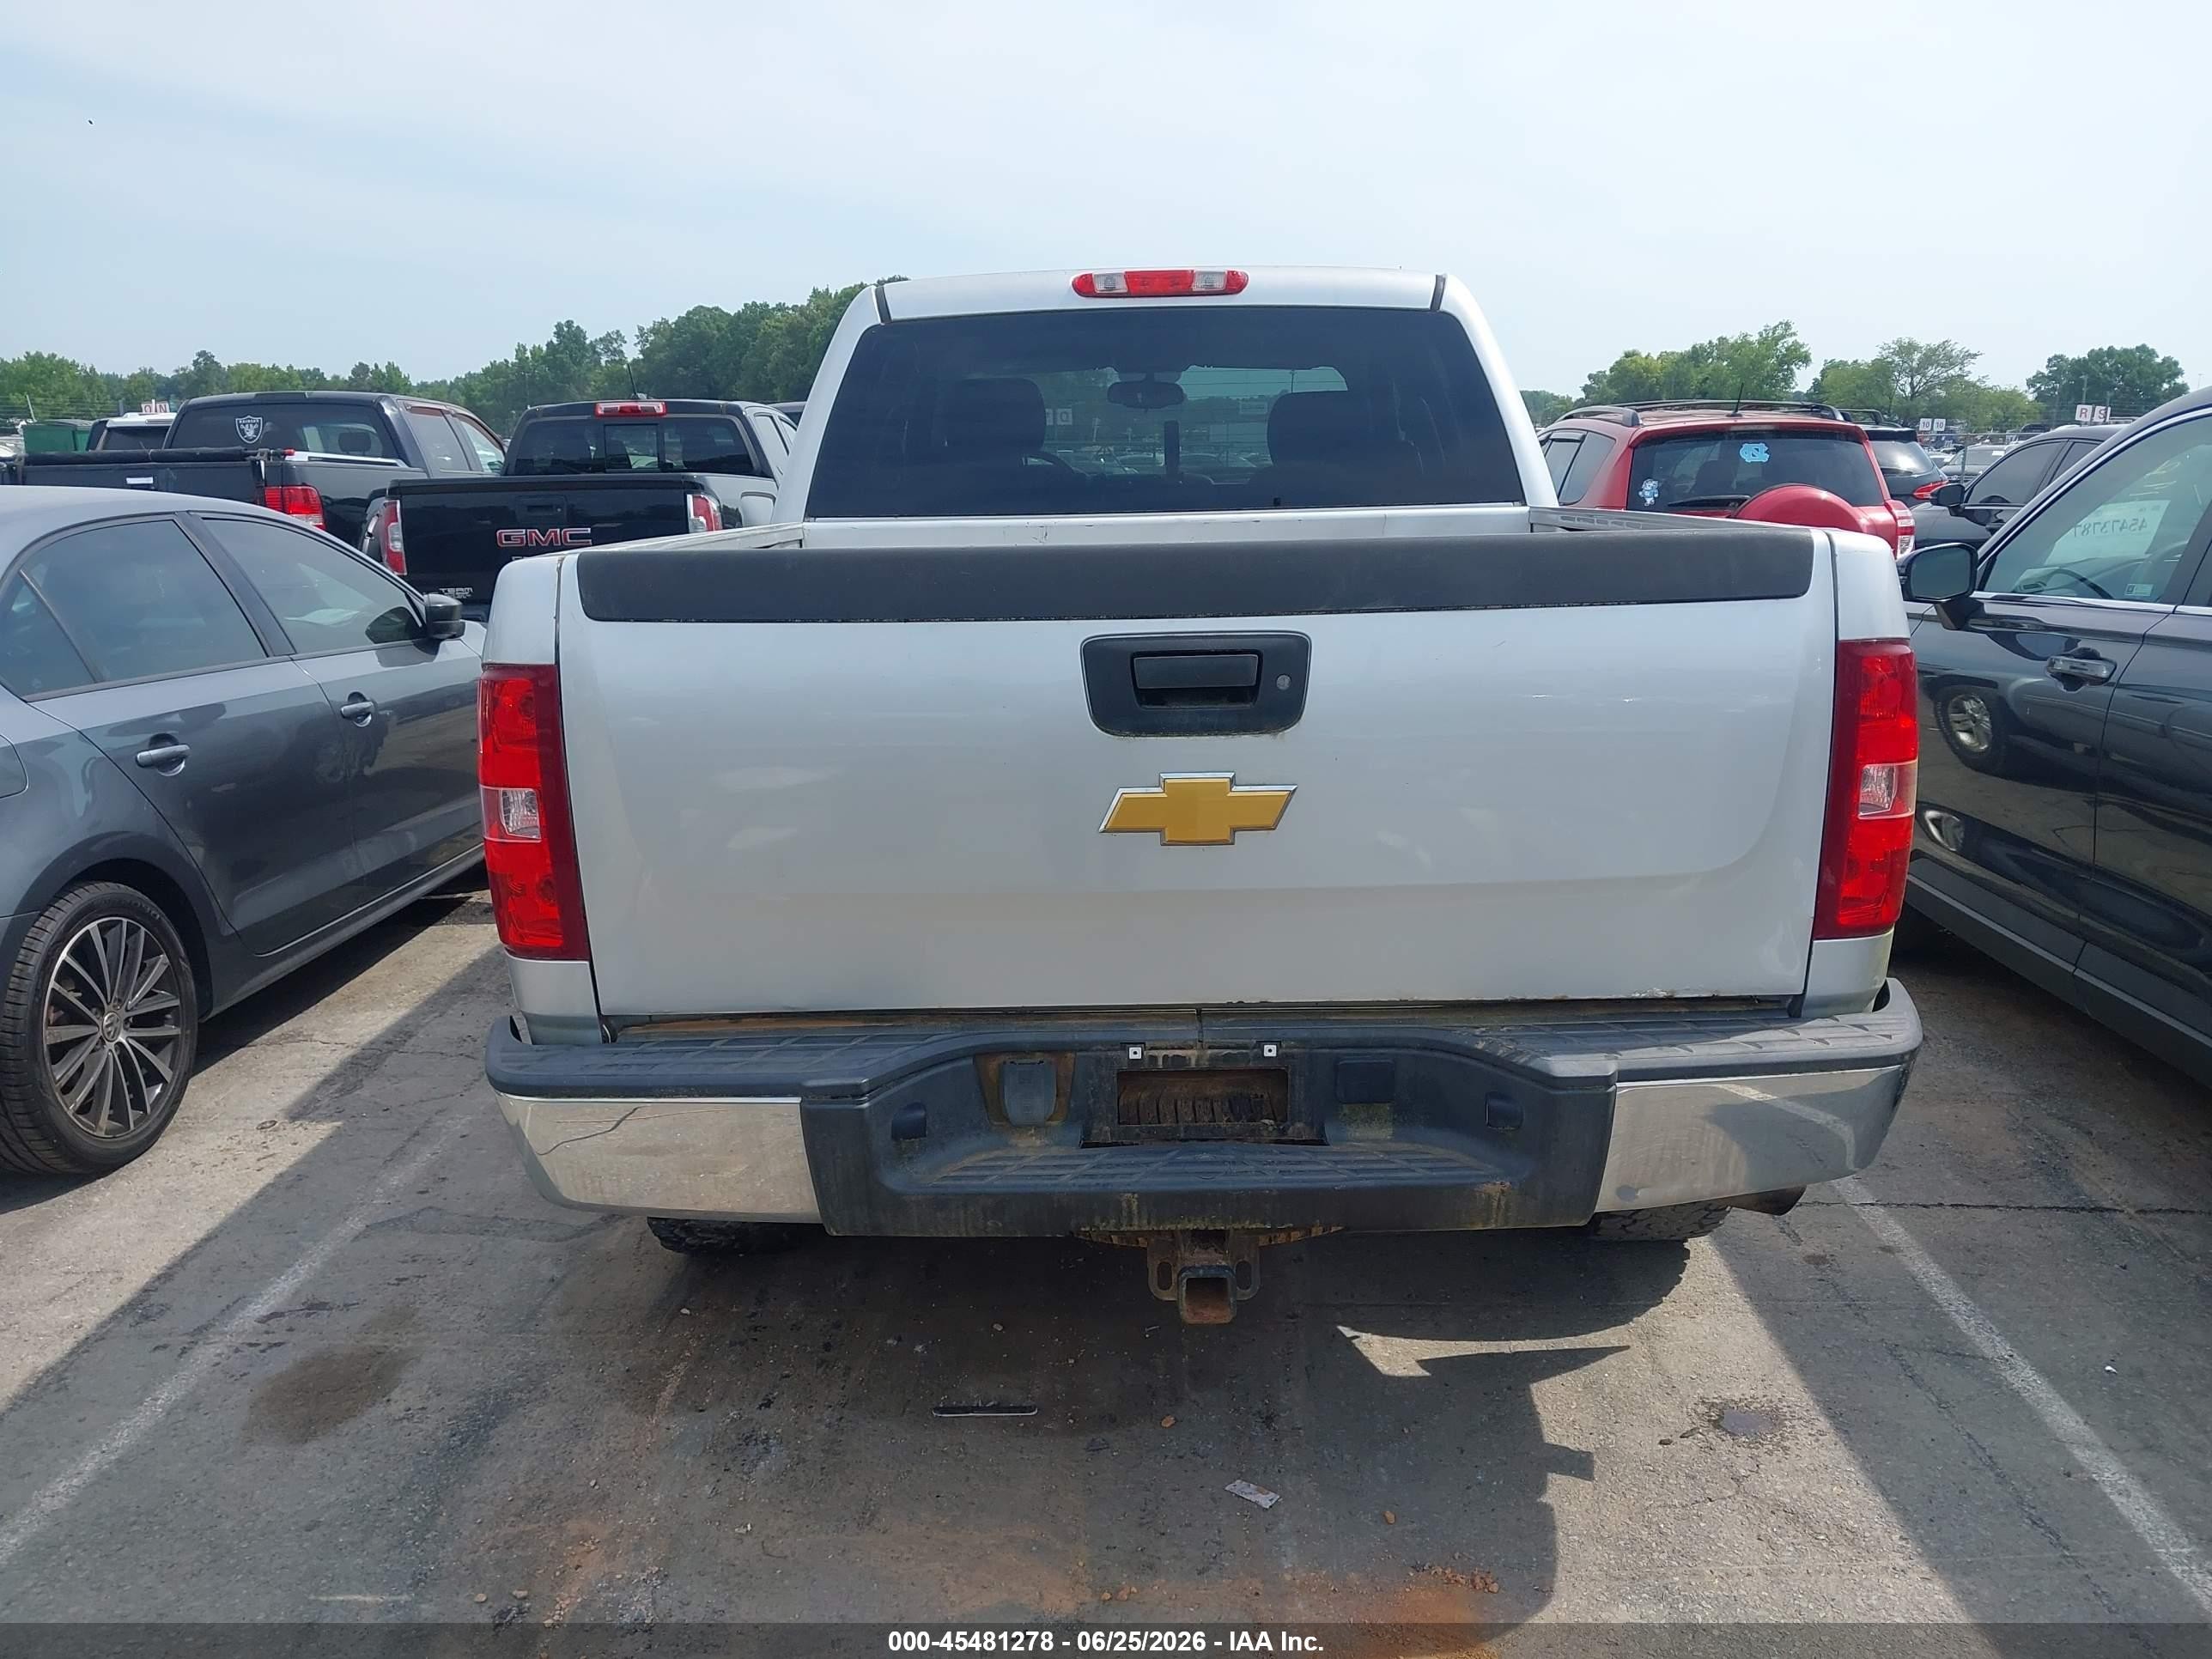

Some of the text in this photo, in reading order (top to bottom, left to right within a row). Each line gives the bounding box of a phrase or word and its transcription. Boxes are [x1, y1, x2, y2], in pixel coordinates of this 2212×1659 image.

[159, 404, 167, 412] N
[2080, 408, 2088, 418] R
[2098, 408, 2107, 419] S
[496, 528, 592, 547] GMC
